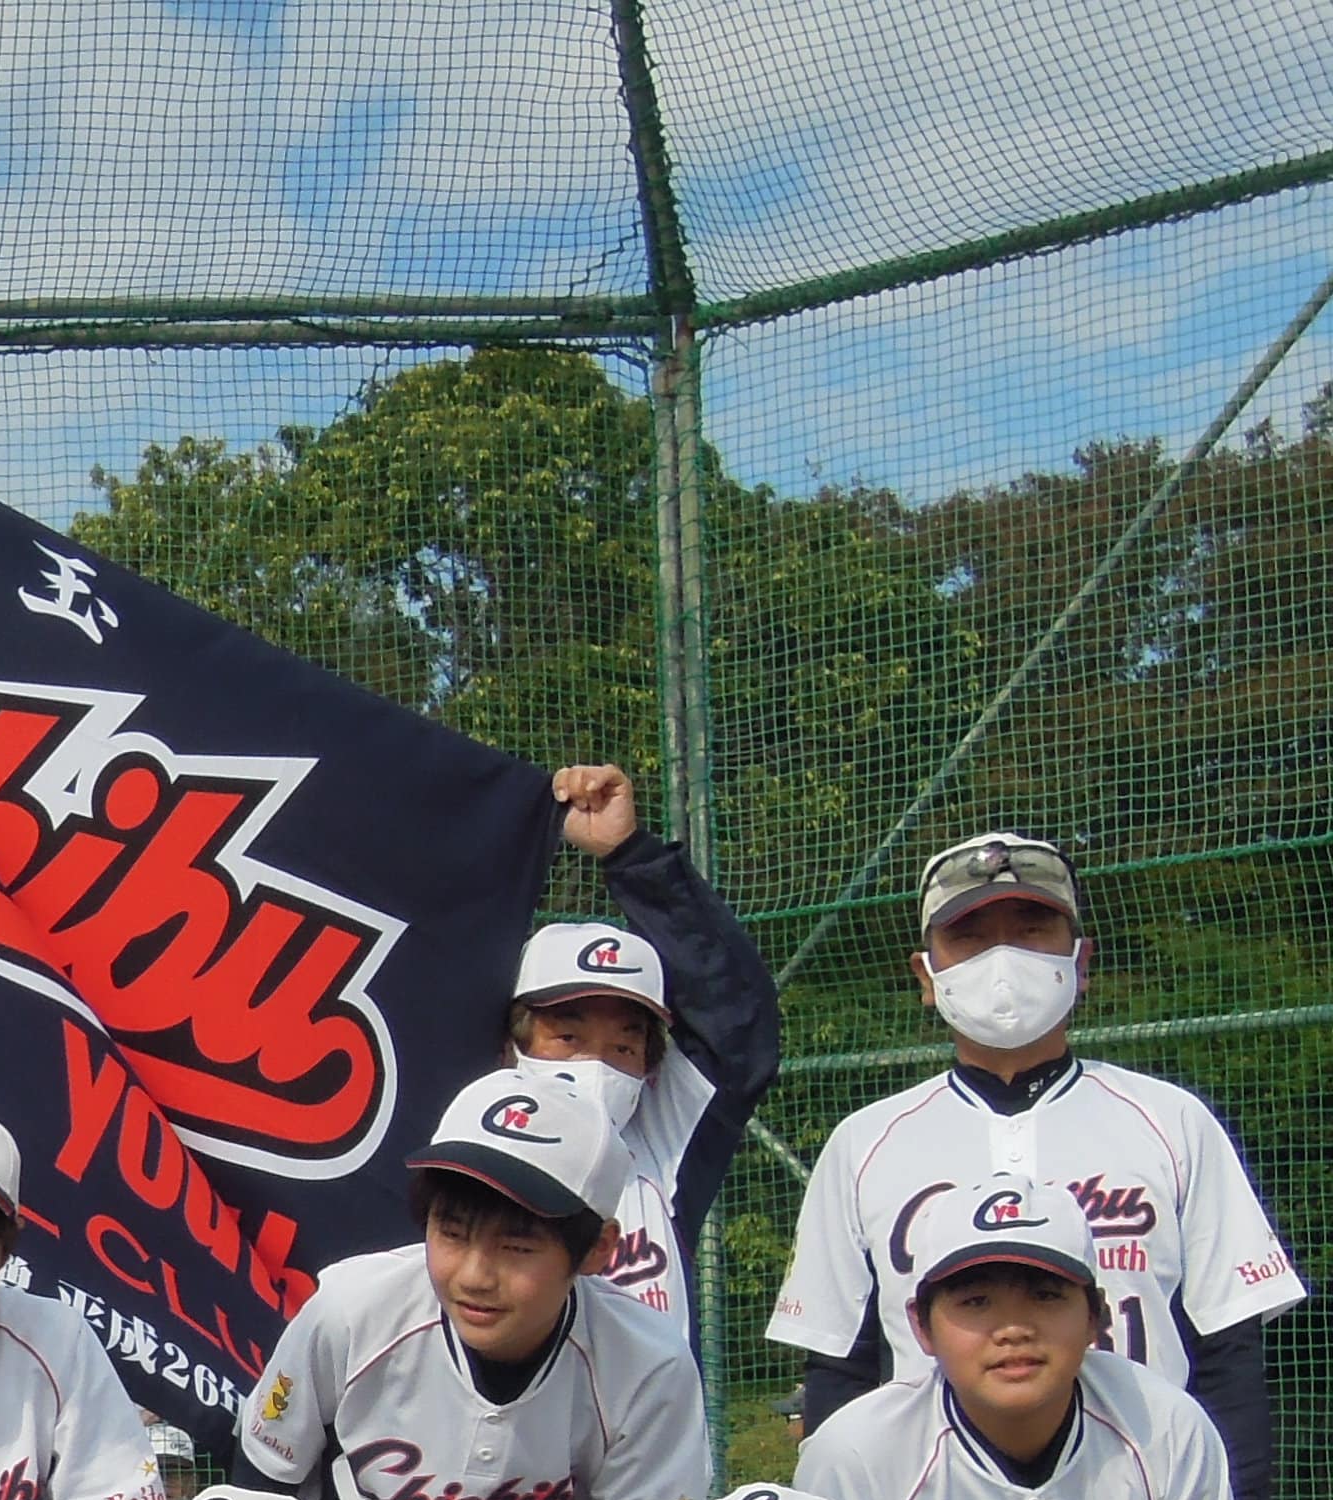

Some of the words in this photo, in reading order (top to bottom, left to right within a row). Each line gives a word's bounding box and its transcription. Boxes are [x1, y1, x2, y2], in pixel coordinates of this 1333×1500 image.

[1098, 1240, 1145, 1272] uth
[1235, 1251, 1286, 1285] Sait
[86, 1214, 264, 1380] CLU
